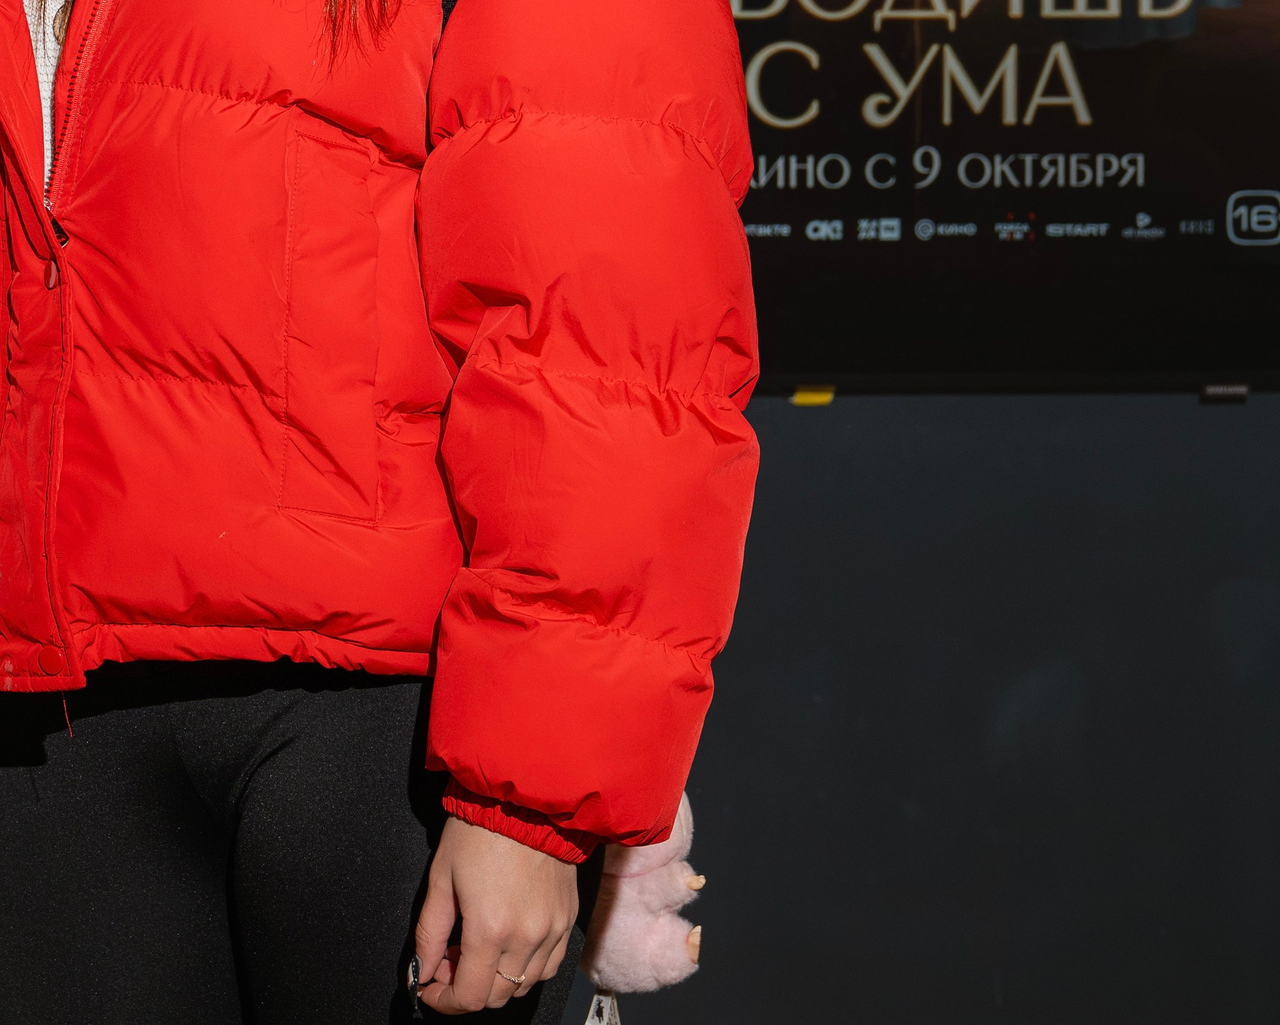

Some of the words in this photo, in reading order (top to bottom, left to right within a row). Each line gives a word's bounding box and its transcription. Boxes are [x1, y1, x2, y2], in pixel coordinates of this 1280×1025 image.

[746, 41, 821, 128] С
[861, 41, 1093, 128] УМА
[749, 153, 851, 190] ИНО
[865, 152, 897, 189] С
[912, 145, 941, 189] 9
[957, 153, 1145, 189] ОКТЯБРЯ
